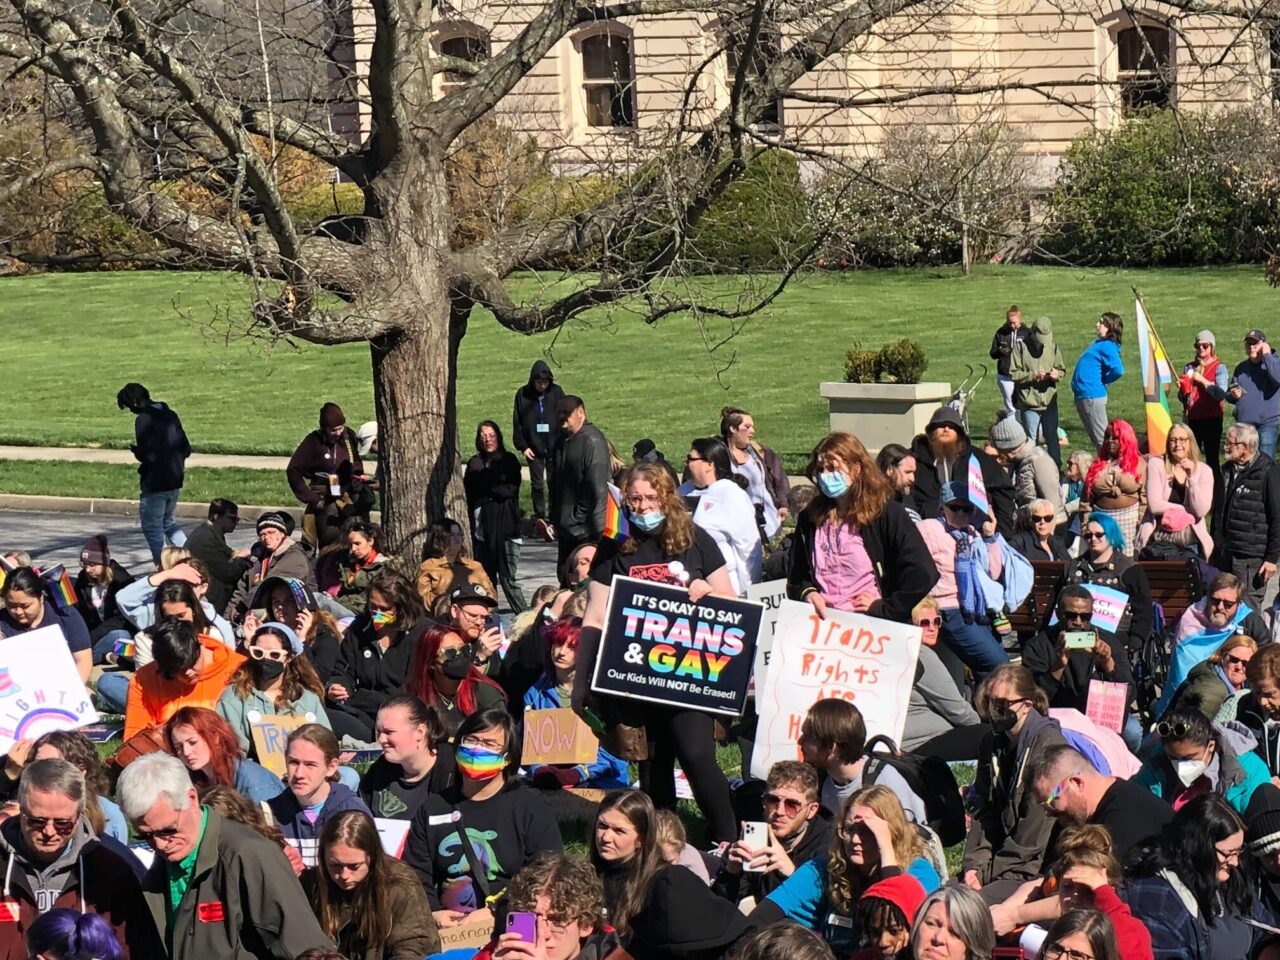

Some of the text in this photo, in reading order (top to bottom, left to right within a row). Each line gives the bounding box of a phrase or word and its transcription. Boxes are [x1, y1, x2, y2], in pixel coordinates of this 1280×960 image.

[632, 593, 743, 625] IT'S OKAY TO SAY
[622, 607, 746, 656] TRANS
[808, 615, 891, 656] Trans
[624, 643, 732, 683] & GAY
[800, 652, 880, 684] Rights
[607, 669, 737, 700] Our Kids Will NOT Be Erased!
